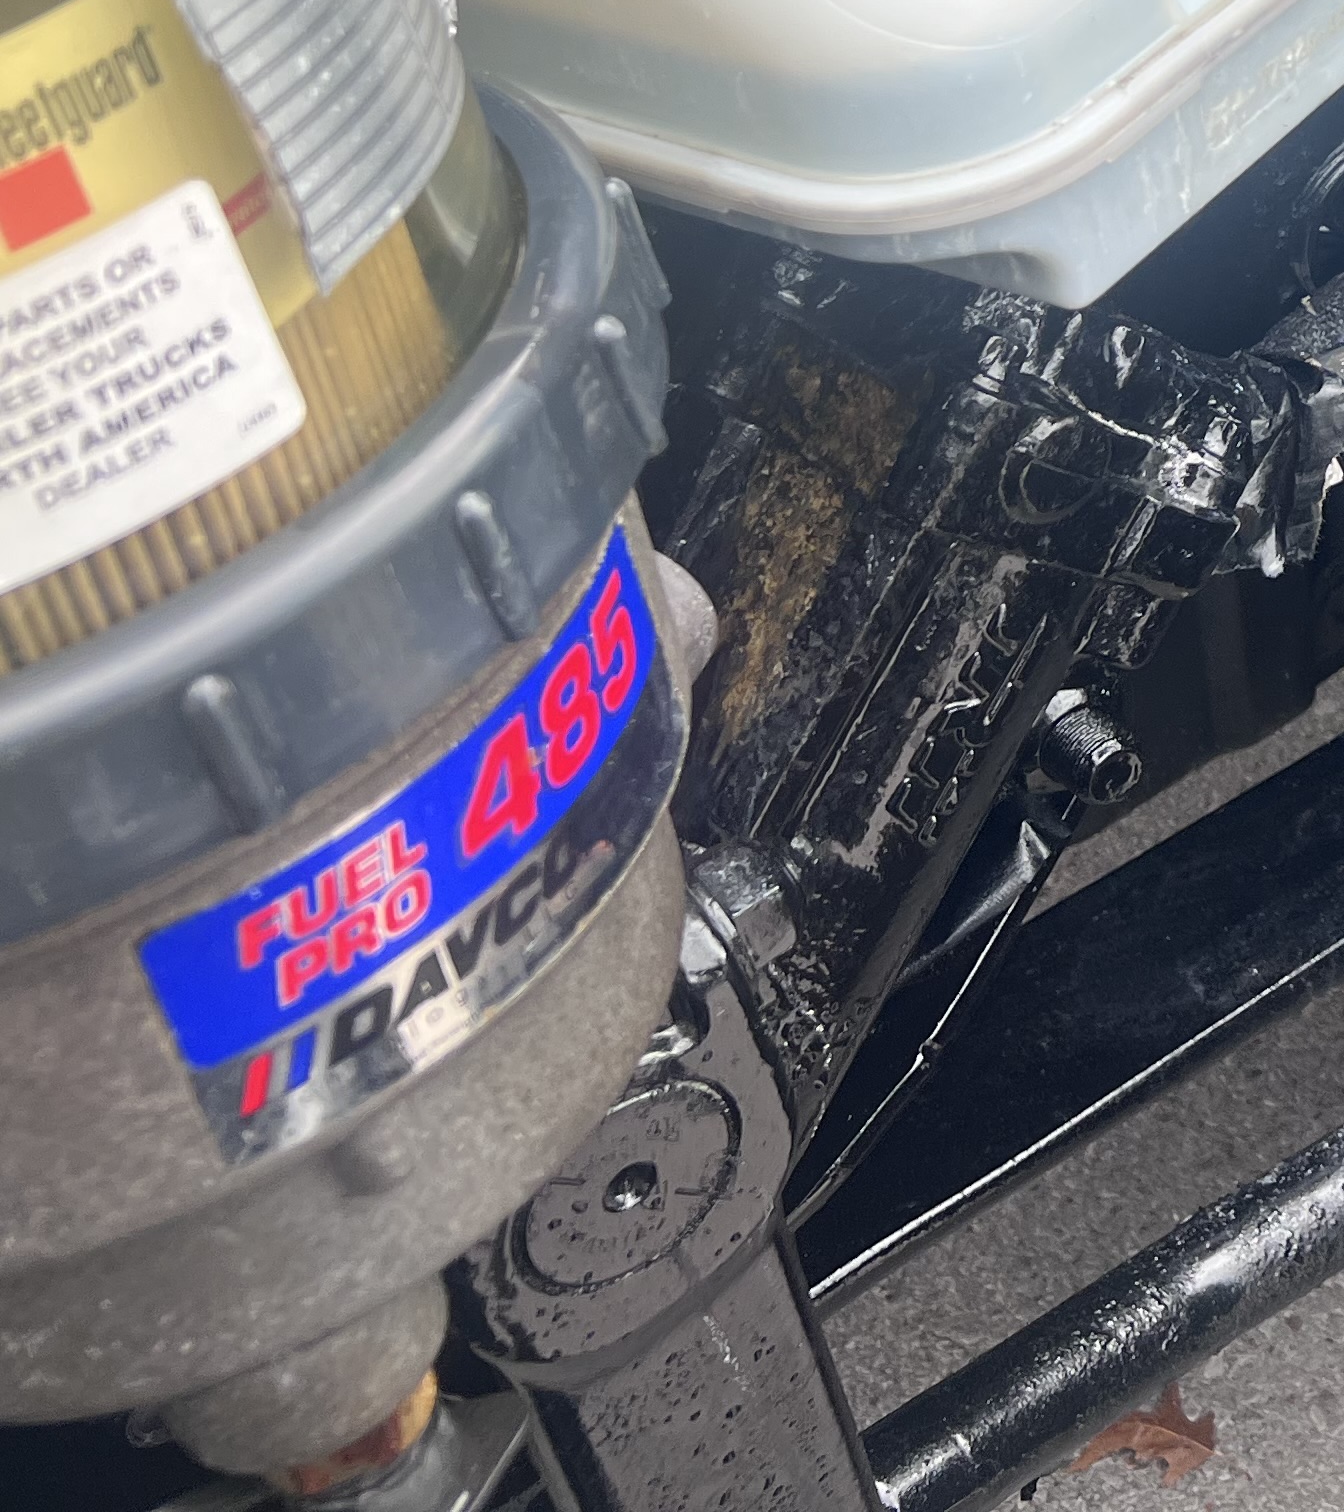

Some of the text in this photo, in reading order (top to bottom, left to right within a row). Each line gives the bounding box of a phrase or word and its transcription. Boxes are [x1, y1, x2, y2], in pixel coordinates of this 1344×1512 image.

[0, 26, 163, 166] eetguard
[0, 245, 157, 334] ARTS OR
[0, 269, 181, 375] ACEMENTS
[48, 327, 147, 387] YOUR
[78, 353, 239, 454] AMERICA
[86, 317, 233, 407] TRUCKS
[33, 427, 175, 511] DEALER
[237, 819, 428, 970] FUEL
[460, 568, 638, 858] 485
[275, 869, 431, 1009] PRO
[328, 824, 581, 1067] DAVCO
